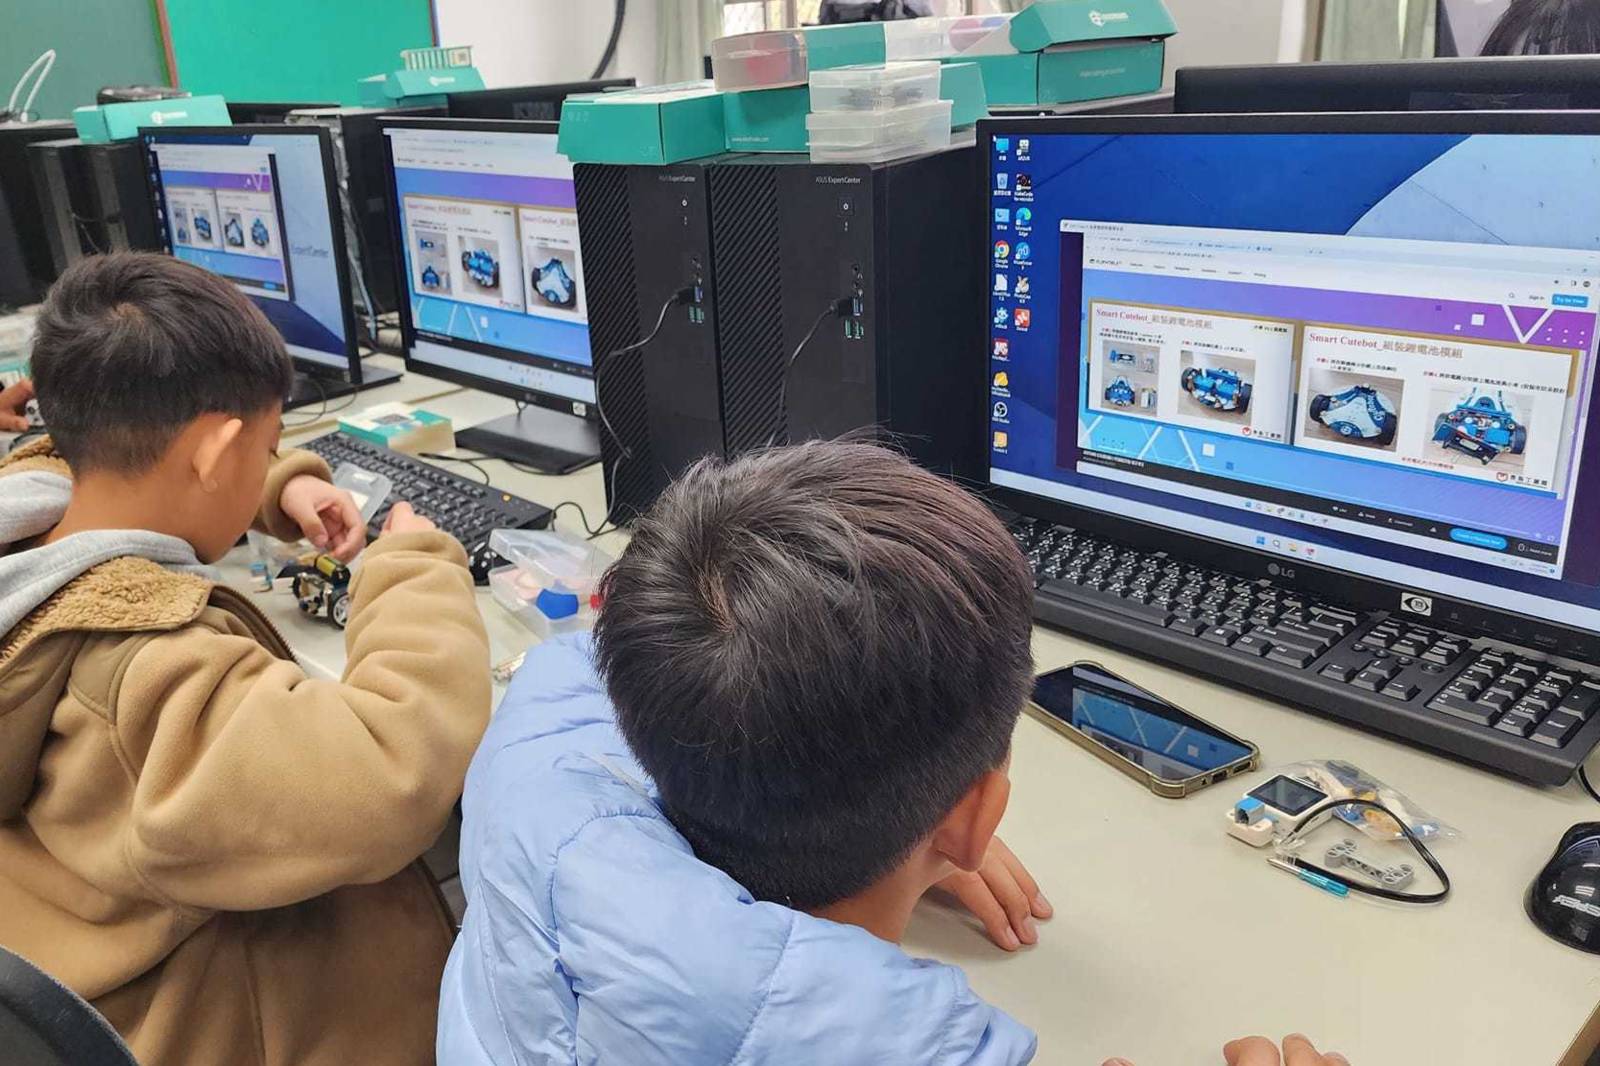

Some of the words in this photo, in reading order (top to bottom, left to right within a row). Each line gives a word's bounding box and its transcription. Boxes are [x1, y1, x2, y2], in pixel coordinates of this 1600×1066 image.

[828, 176, 861, 184] ExpertCenter
[1096, 308, 1118, 318] Smart
[1309, 333, 1338, 344] Smart
[1280, 567, 1296, 579] LG
